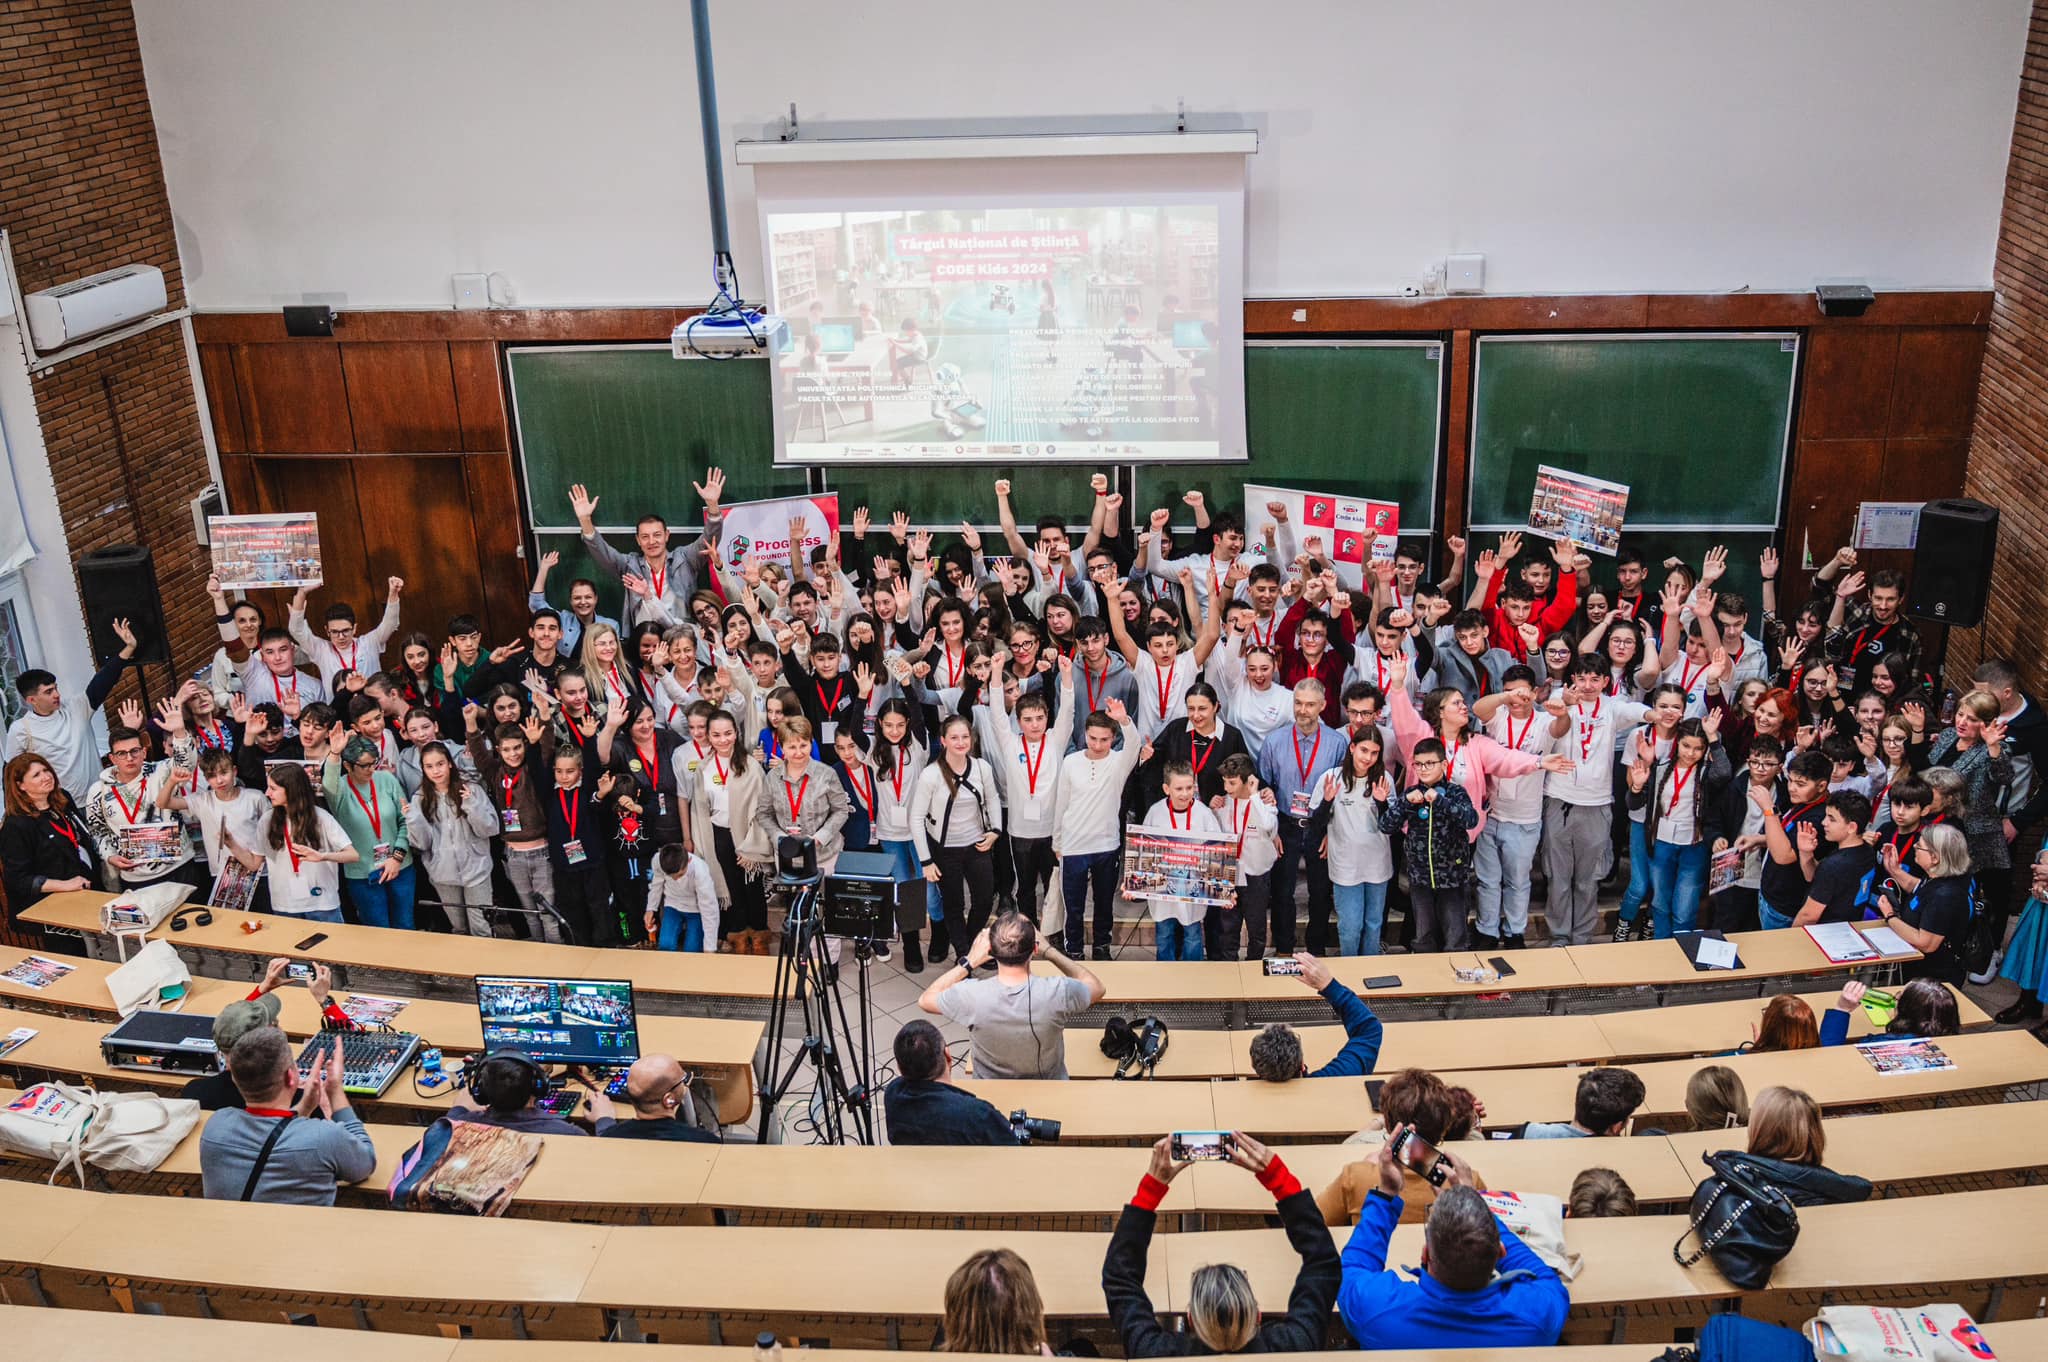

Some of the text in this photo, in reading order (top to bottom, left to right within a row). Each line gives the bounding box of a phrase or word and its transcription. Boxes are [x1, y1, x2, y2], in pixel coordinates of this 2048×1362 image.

[1011, 236, 1028, 248] de
[936, 262, 1048, 276] CODE Kids 2024
